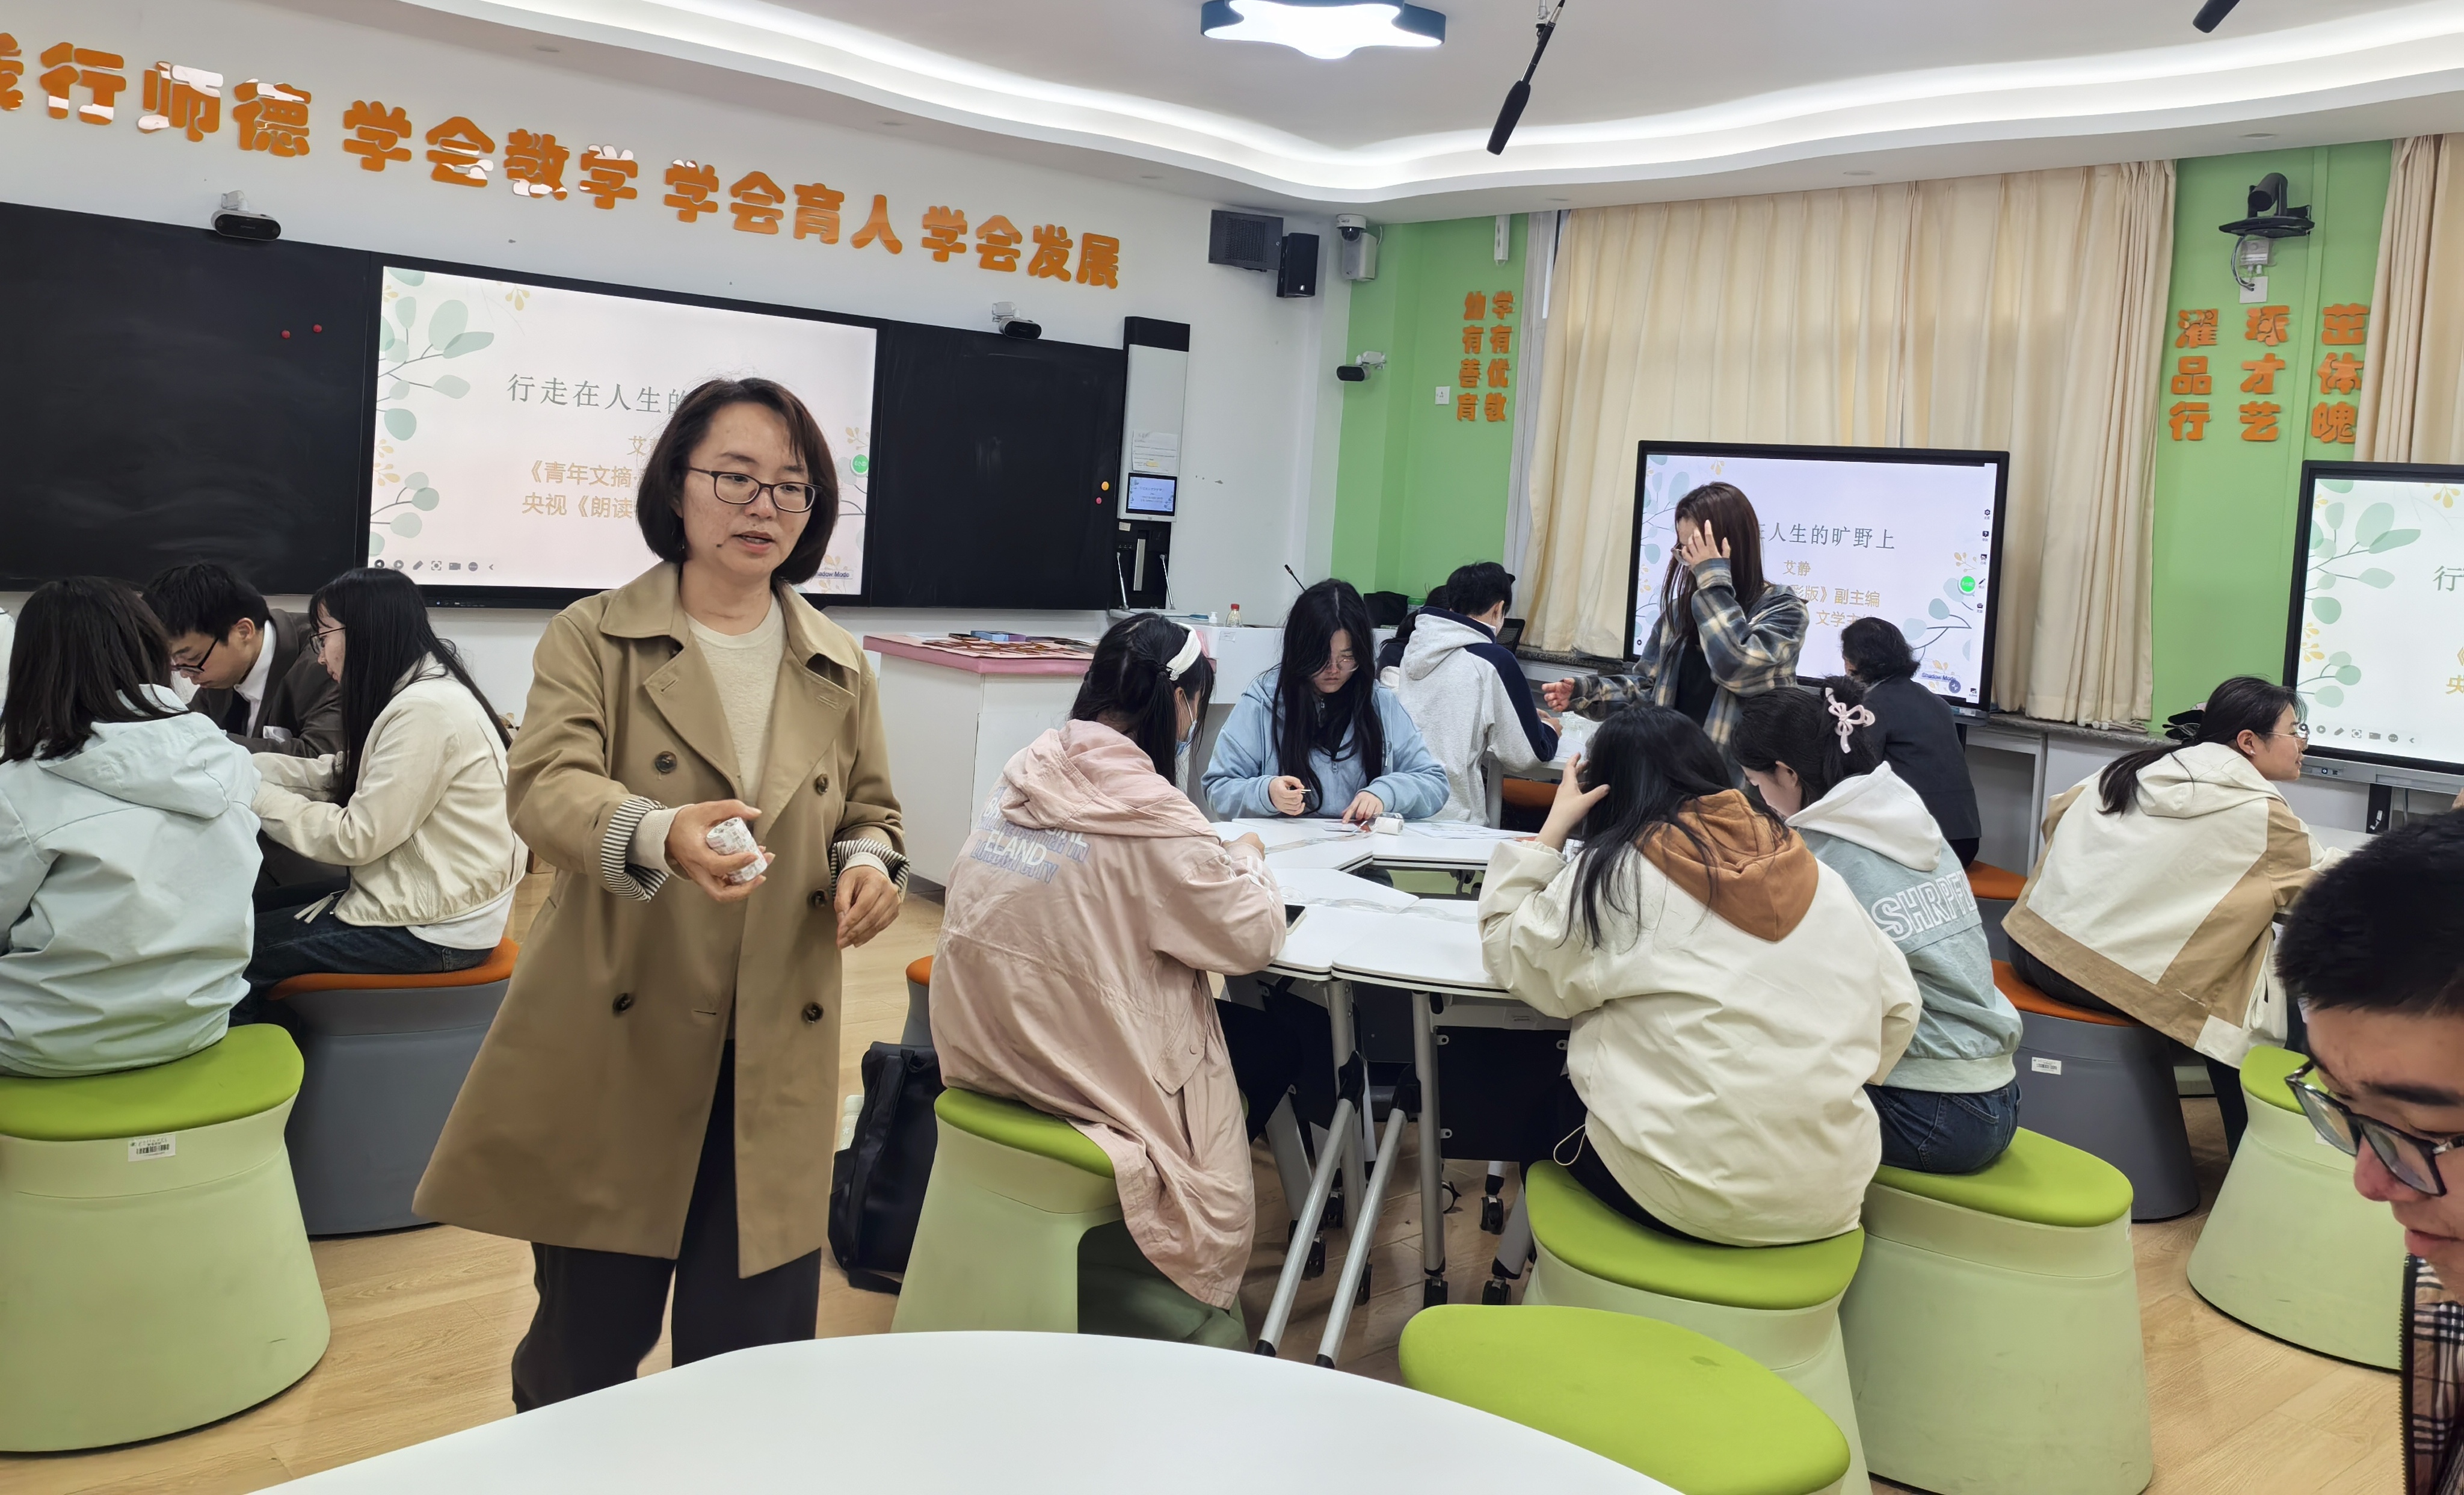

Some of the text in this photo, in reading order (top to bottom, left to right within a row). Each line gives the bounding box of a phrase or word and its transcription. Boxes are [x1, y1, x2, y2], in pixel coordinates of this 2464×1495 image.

[343, 99, 638, 209] 学会教学
[663, 159, 903, 255] 学会育人
[920, 206, 1120, 289] 学会发展
[507, 374, 686, 415] 行走在人生的
[1782, 559, 1811, 577] 艾静
[1816, 609, 1873, 627] 文学主
